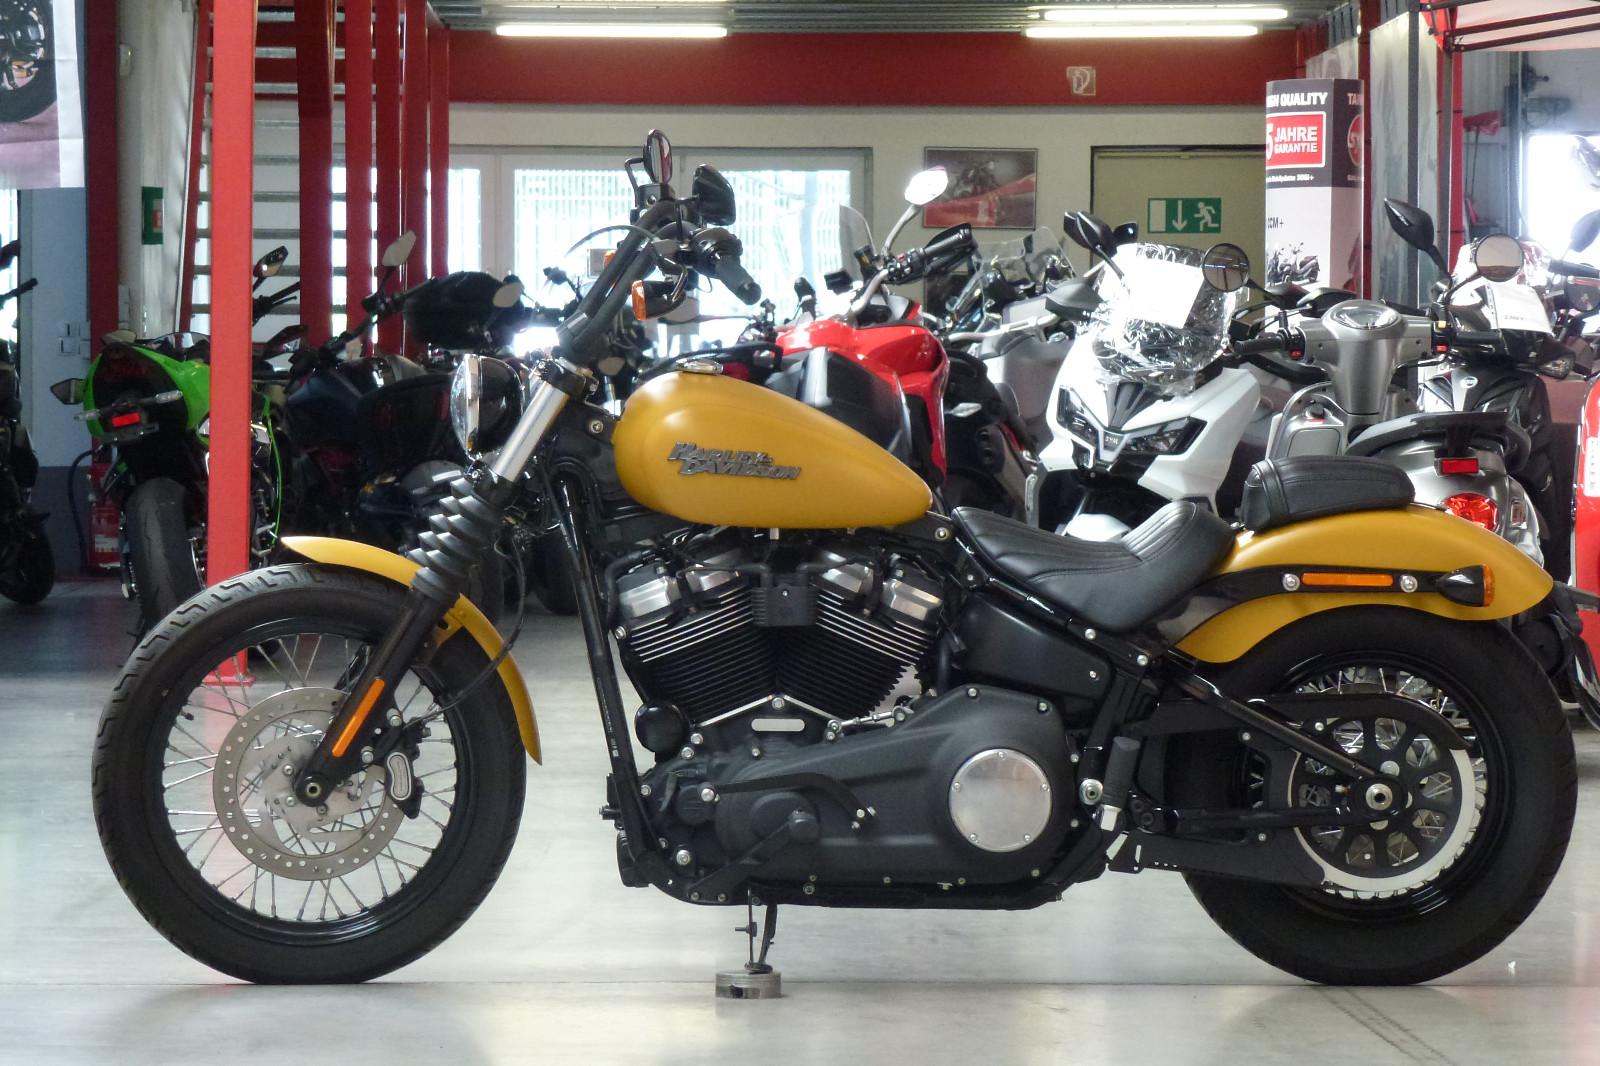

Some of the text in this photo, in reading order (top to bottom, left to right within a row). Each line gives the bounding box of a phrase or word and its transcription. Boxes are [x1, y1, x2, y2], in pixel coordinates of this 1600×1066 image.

[1280, 92, 1328, 107] QUALITY
[1274, 126, 1318, 143] JAHRE
[1274, 143, 1318, 154] GARANTIE
[679, 459, 802, 480] DAVIDSON
